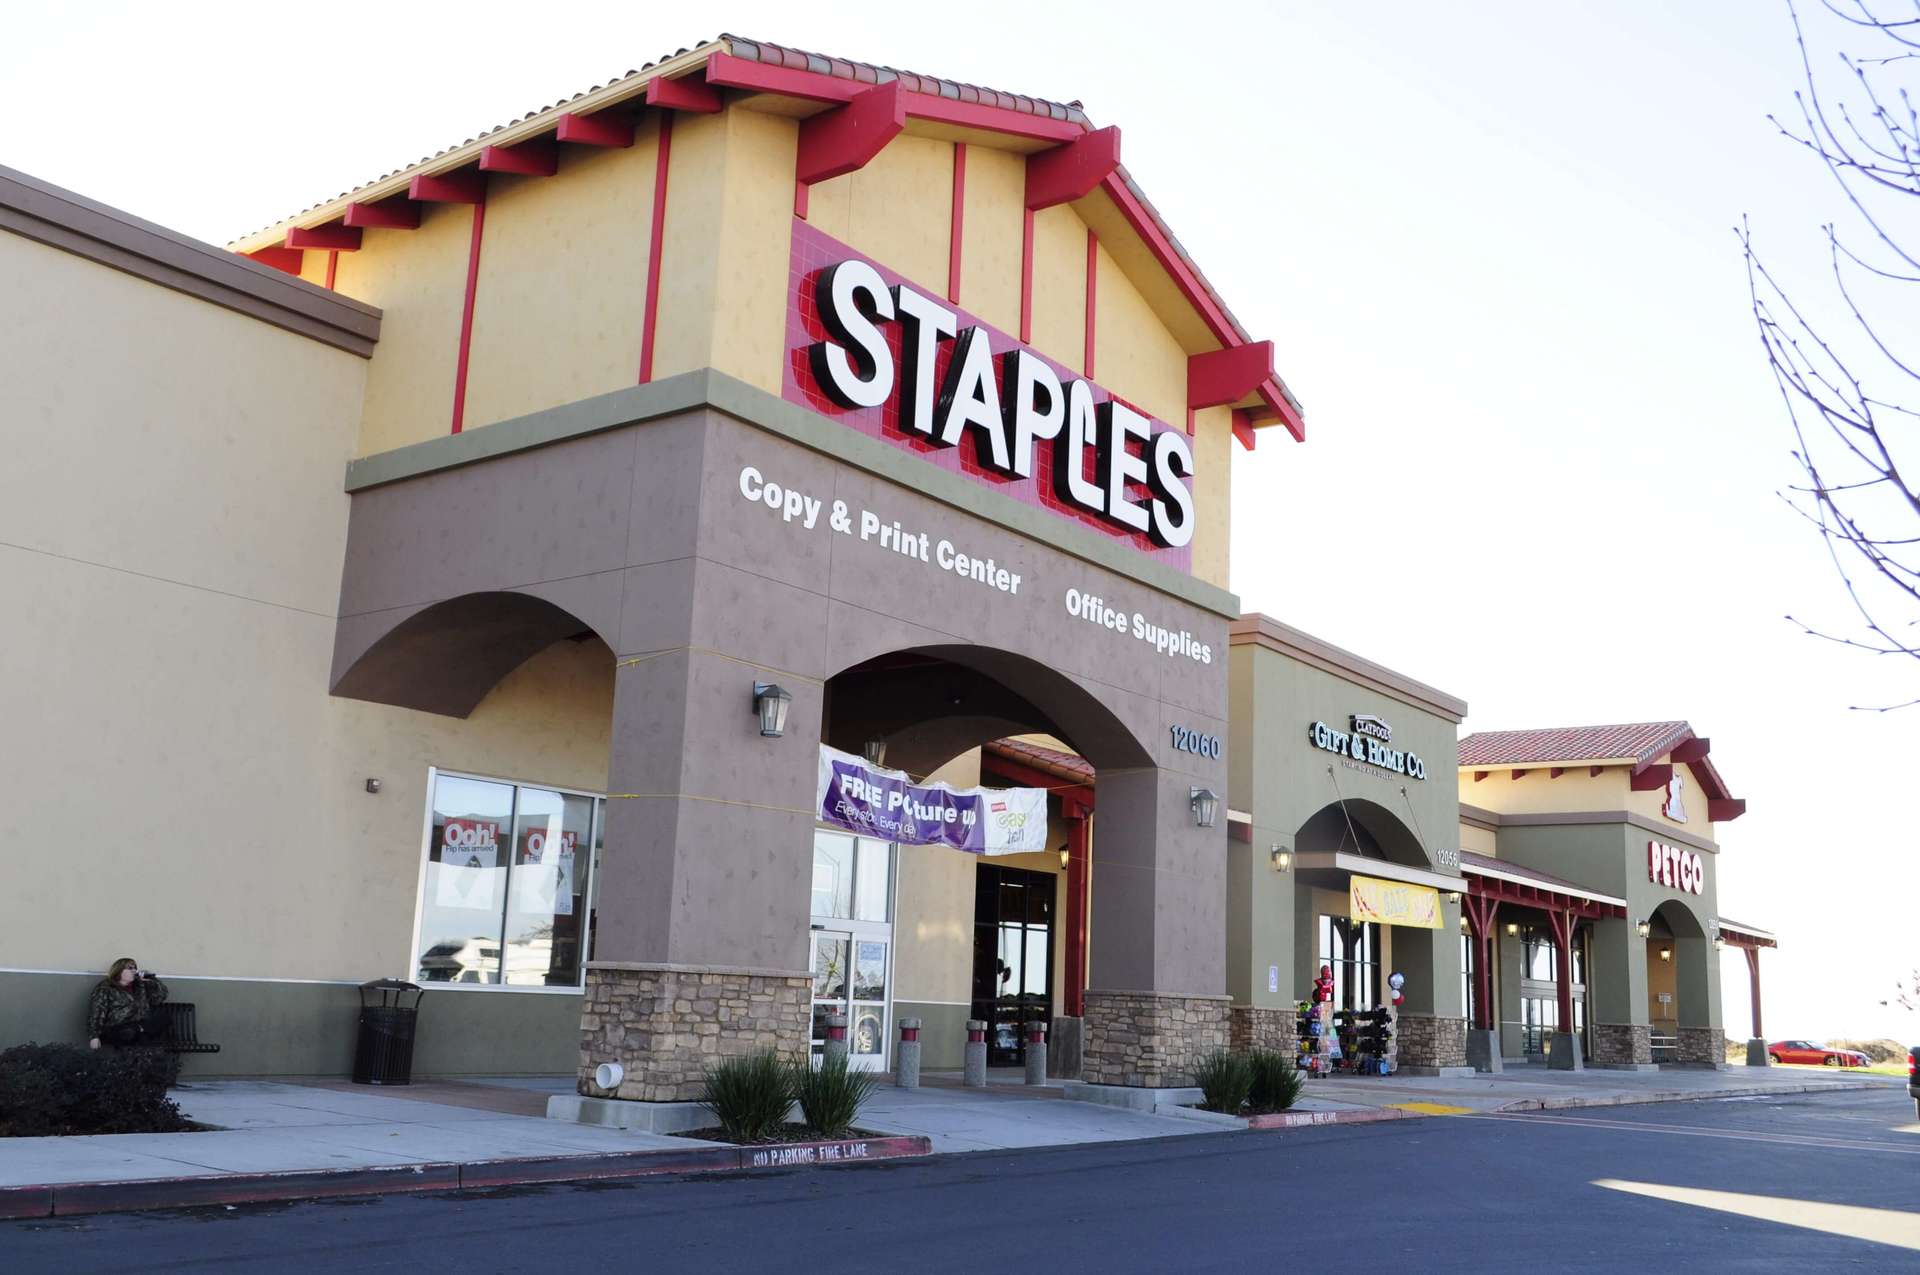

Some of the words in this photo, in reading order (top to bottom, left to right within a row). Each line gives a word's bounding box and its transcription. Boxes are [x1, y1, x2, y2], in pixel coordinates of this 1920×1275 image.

[811, 259, 1195, 548] STAPLES
[739, 466, 821, 530] Copy
[829, 499, 852, 535] &
[860, 510, 929, 563] Print
[936, 539, 1021, 595] Center
[1065, 588, 1128, 633] Office
[1132, 612, 1212, 664] Supplies
[1170, 725, 1221, 761] 12060
[1313, 720, 1349, 756] GIFT
[1350, 732, 1366, 761] &
[1366, 737, 1405, 773] HOME
[445, 823, 496, 847] Ooh!
[879, 815, 903, 833] Every
[962, 808, 977, 829] up
[1649, 840, 1704, 896] PETCO
[770, 1147, 814, 1167] PARKING
[819, 1144, 841, 1161] FIRE
[842, 1142, 868, 1158] LANE
